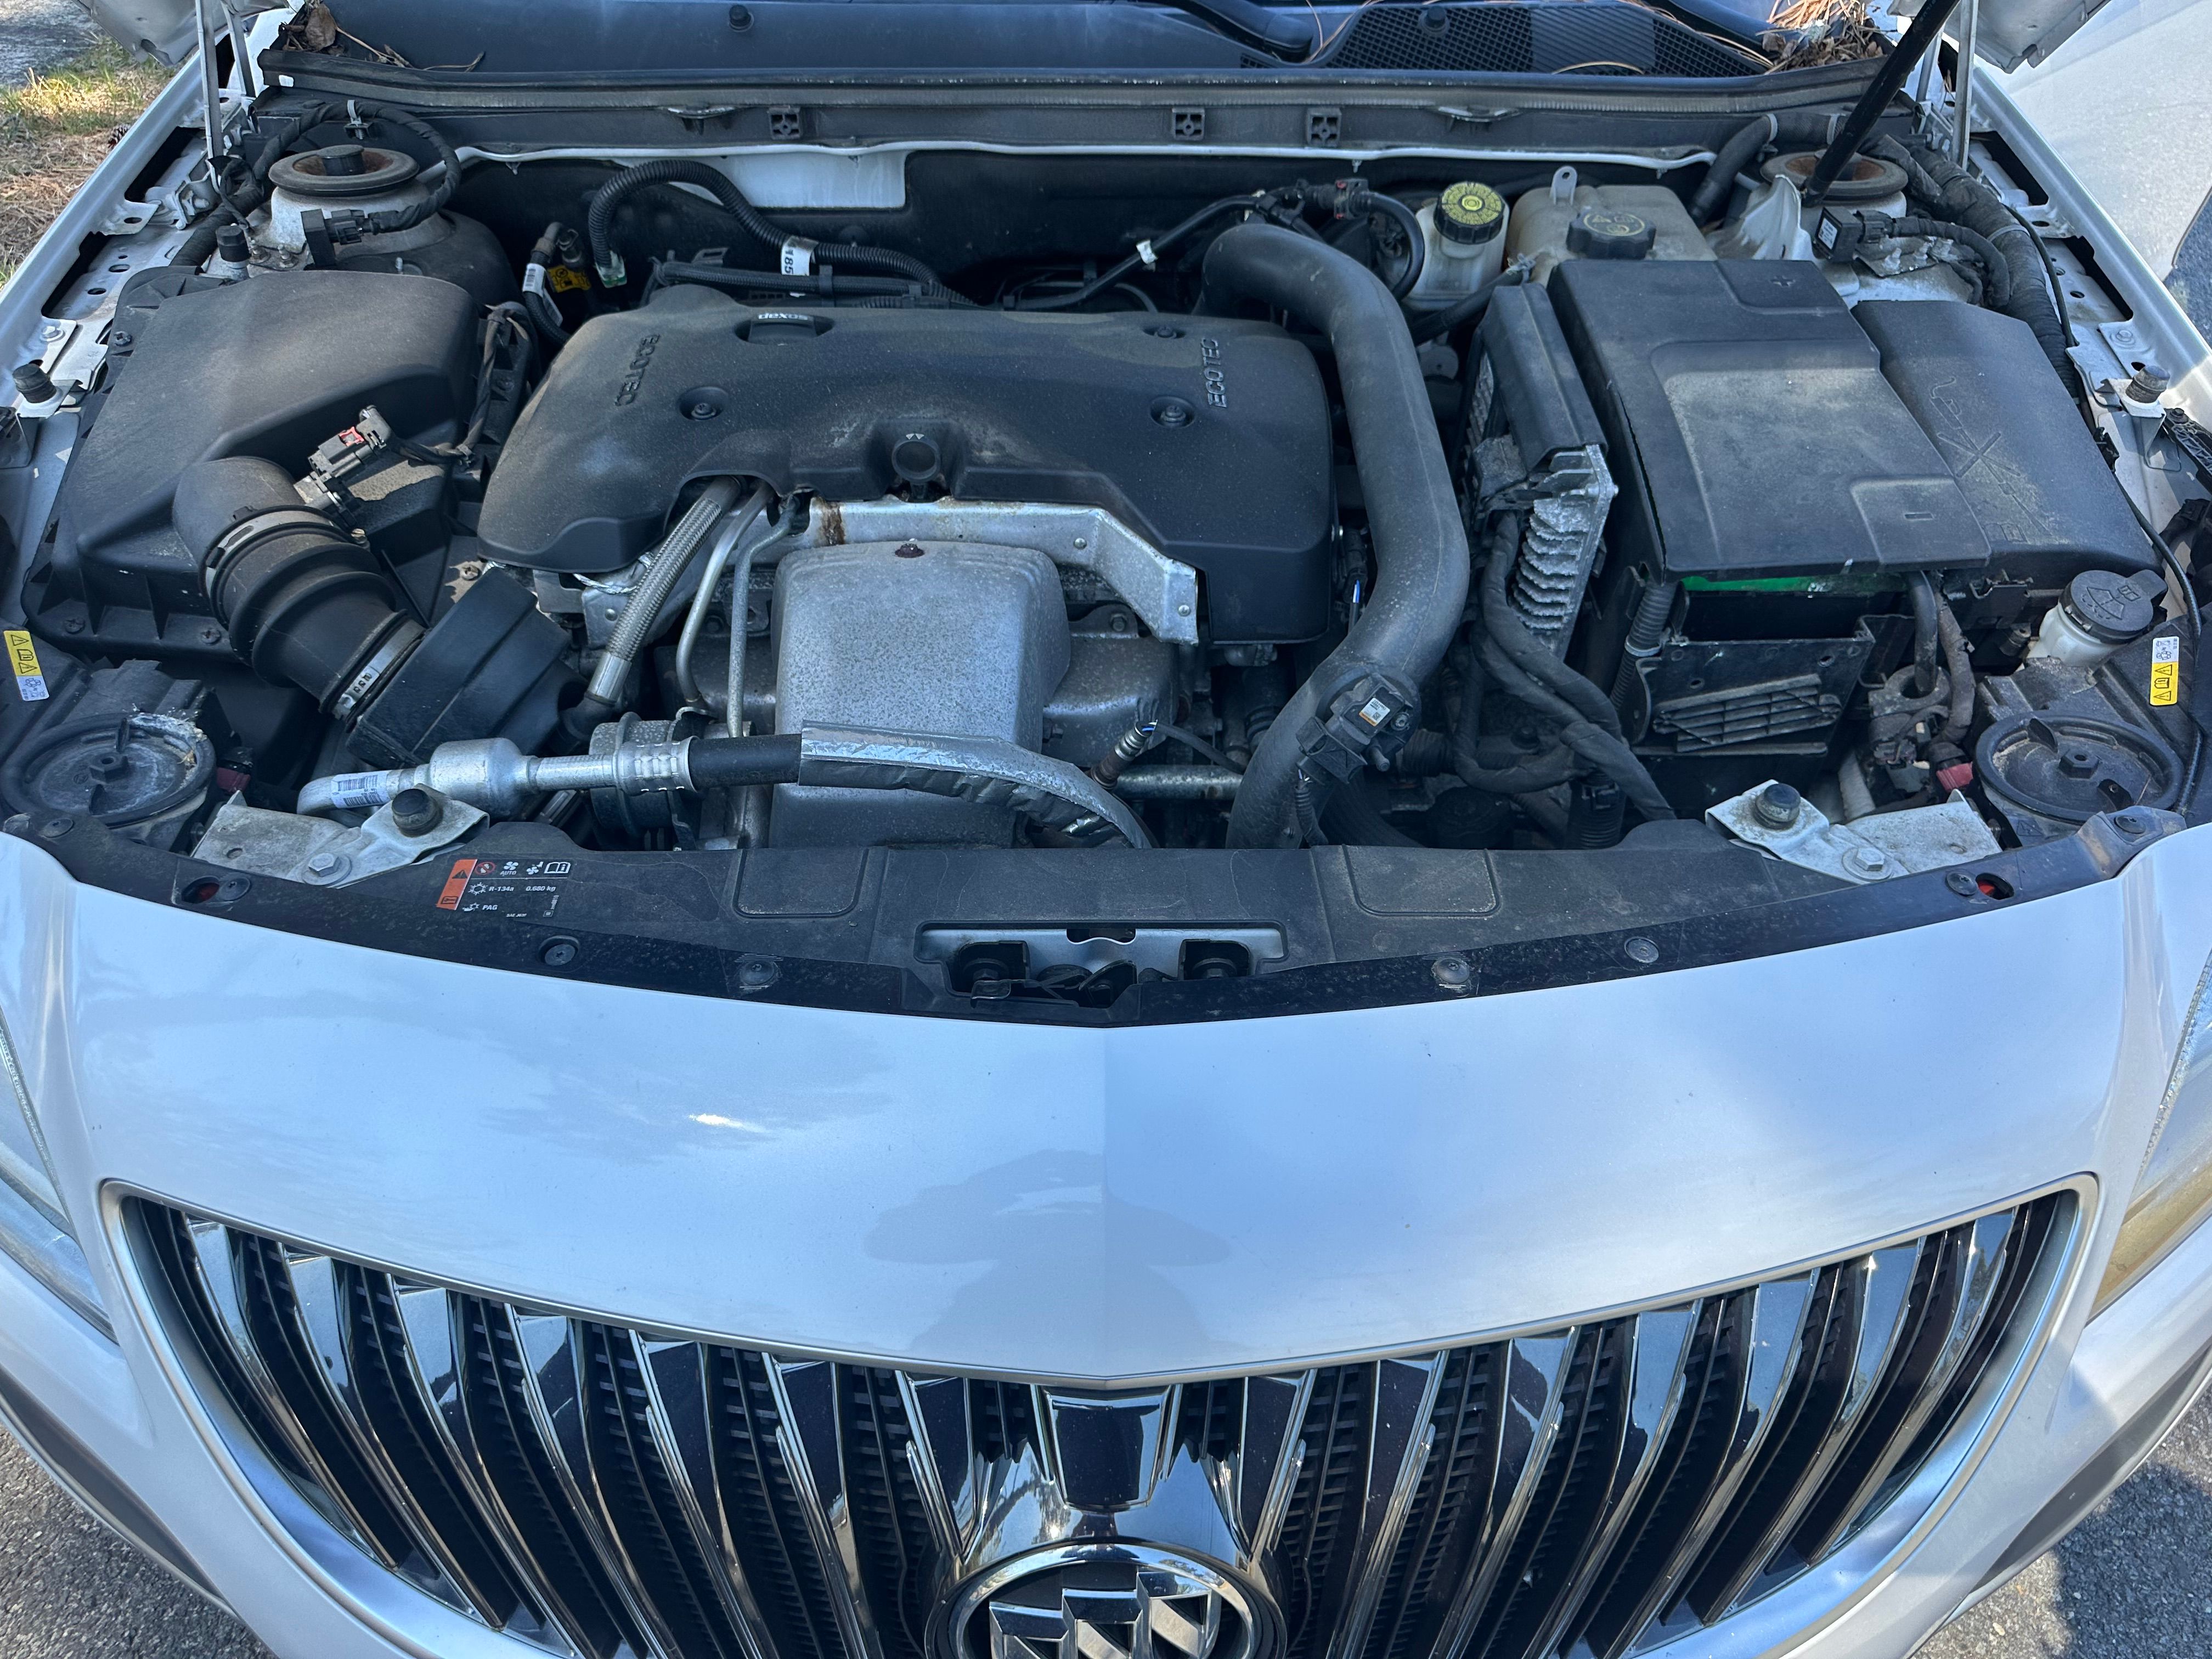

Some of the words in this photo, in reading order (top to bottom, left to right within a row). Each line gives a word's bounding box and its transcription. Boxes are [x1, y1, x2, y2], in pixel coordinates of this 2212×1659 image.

[784, 250, 794, 275] 185
[758, 312, 808, 320] dexos
[614, 334, 661, 407] ECOTEC
[1200, 337, 1228, 408] ECOTEC
